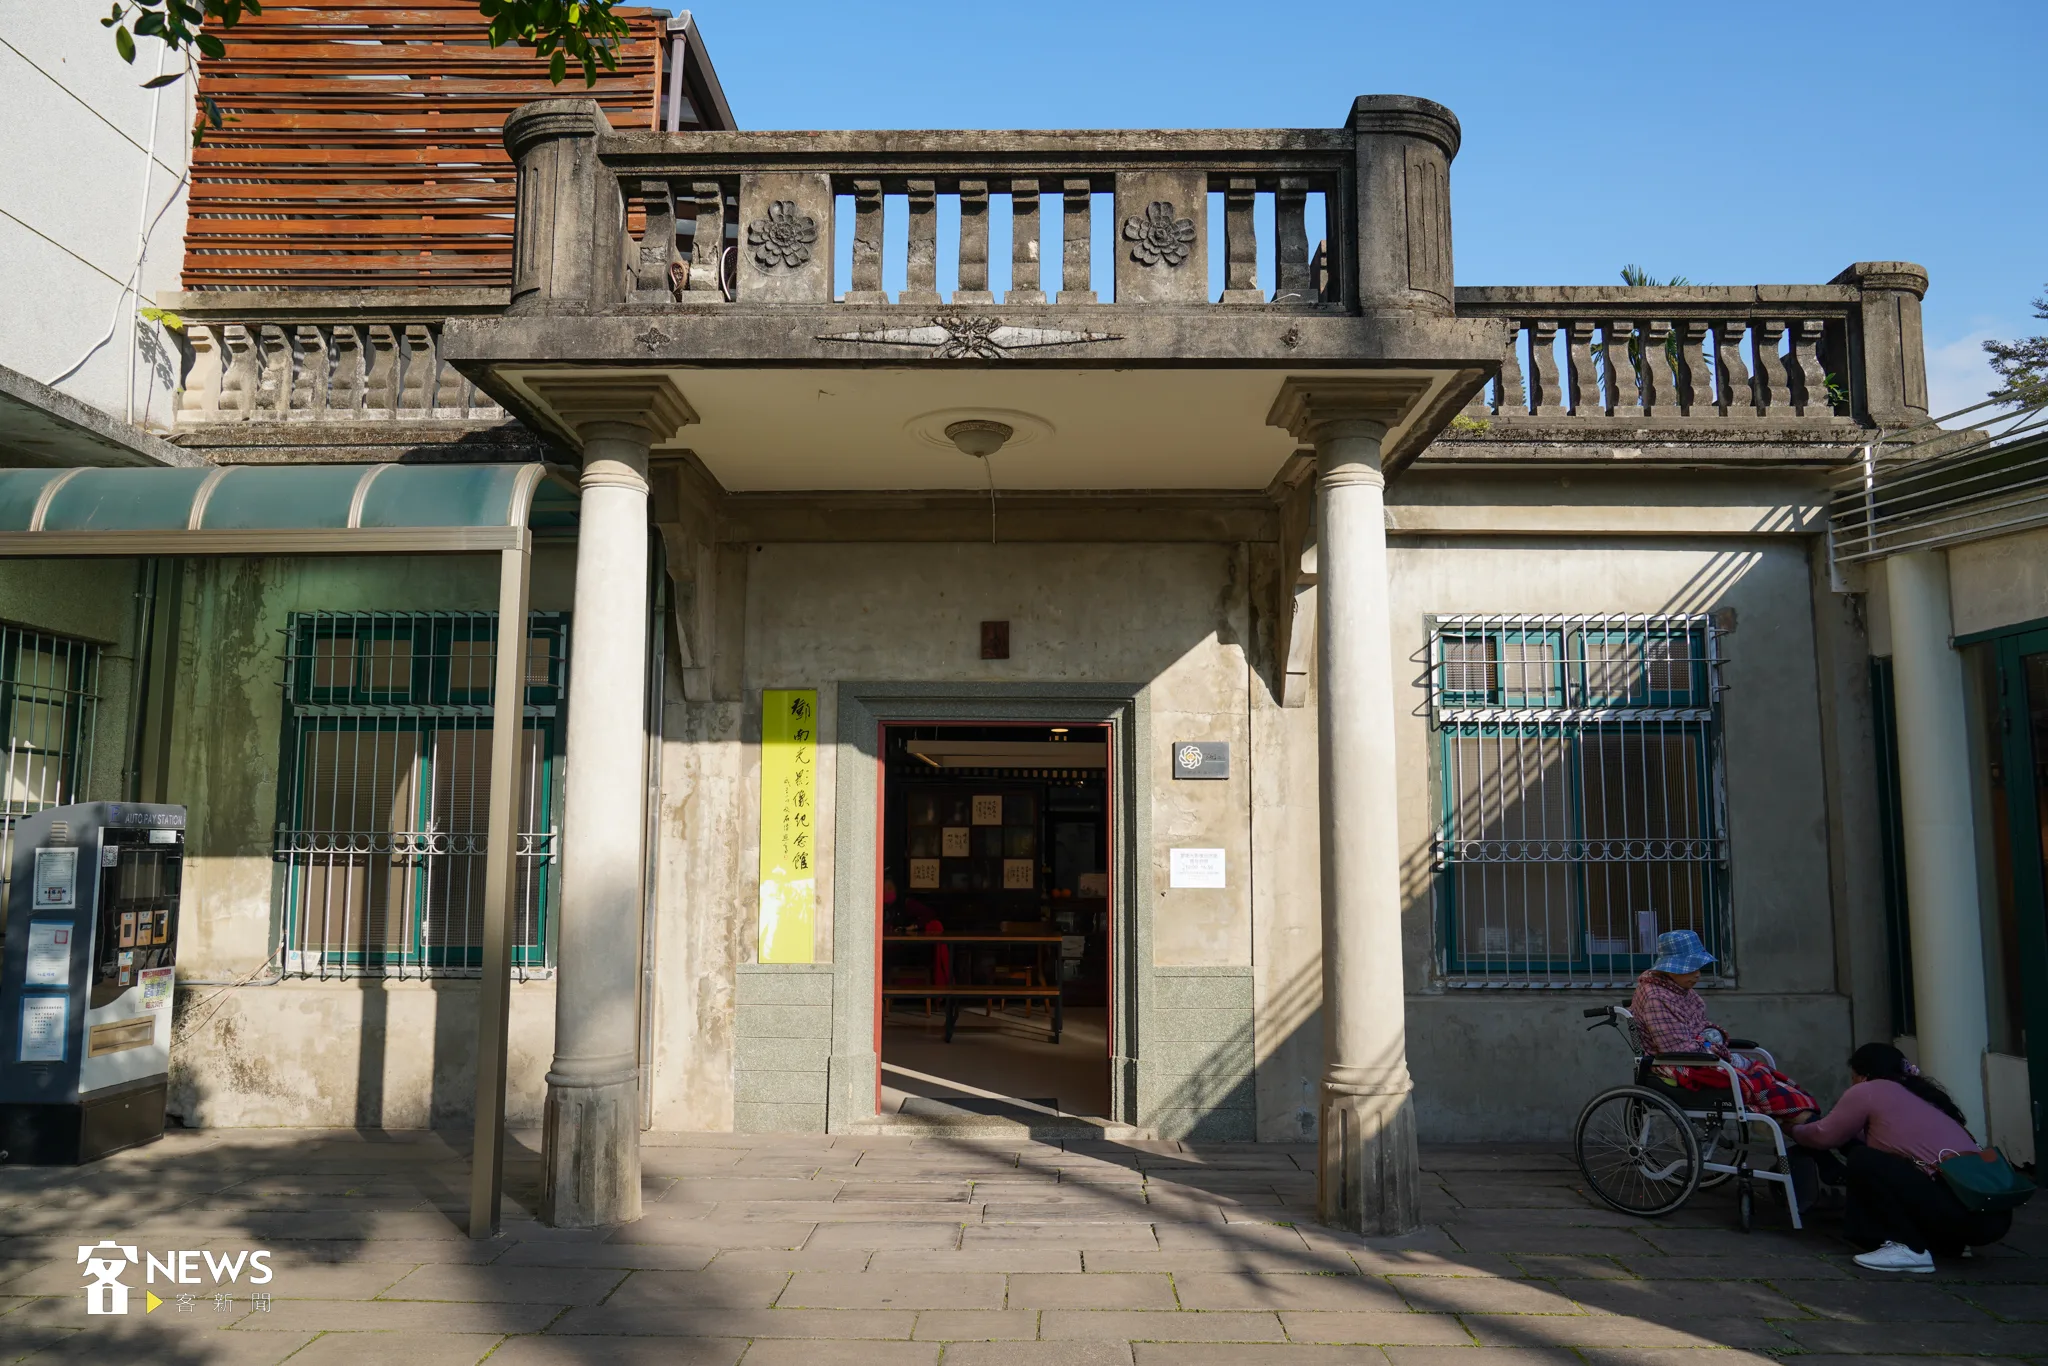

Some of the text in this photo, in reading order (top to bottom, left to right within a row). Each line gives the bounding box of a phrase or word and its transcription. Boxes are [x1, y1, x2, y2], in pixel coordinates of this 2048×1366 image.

[125, 813, 183, 825] AUTO PAY STATION
[791, 697, 811, 870] 鄧南光影像紀念館
